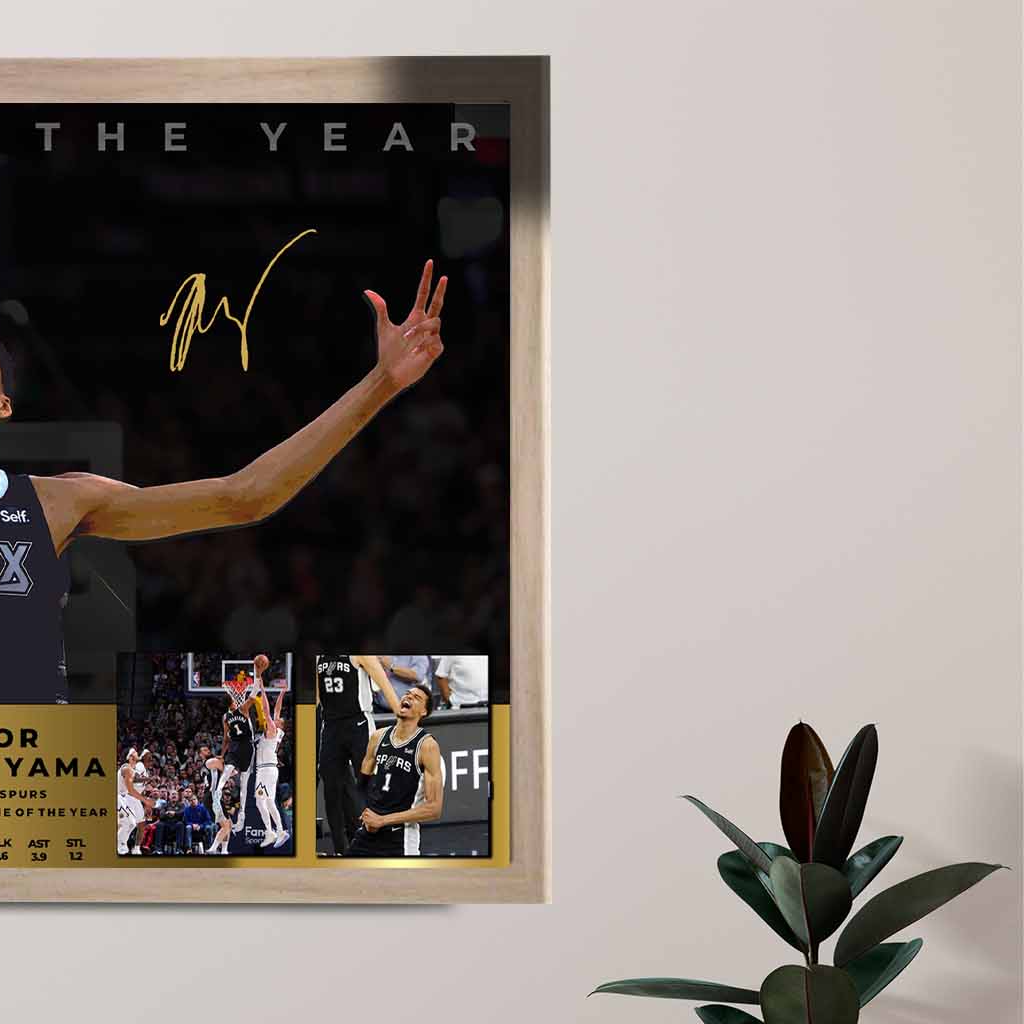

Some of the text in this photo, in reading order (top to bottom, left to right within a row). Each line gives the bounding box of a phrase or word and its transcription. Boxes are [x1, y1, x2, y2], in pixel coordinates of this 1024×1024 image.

[36, 123, 186, 150] THE
[261, 123, 475, 150] YEAR
[324, 677, 344, 693] 23
[440, 749, 488, 791] FF
[382, 773, 391, 792] 1
[0, 790, 47, 799] SPURS
[17, 808, 34, 817] OF
[38, 808, 66, 817] THE
[70, 808, 108, 817] YEAR
[28, 839, 50, 848] AST
[66, 839, 86, 848] STL
[31, 852, 47, 861] 3.9
